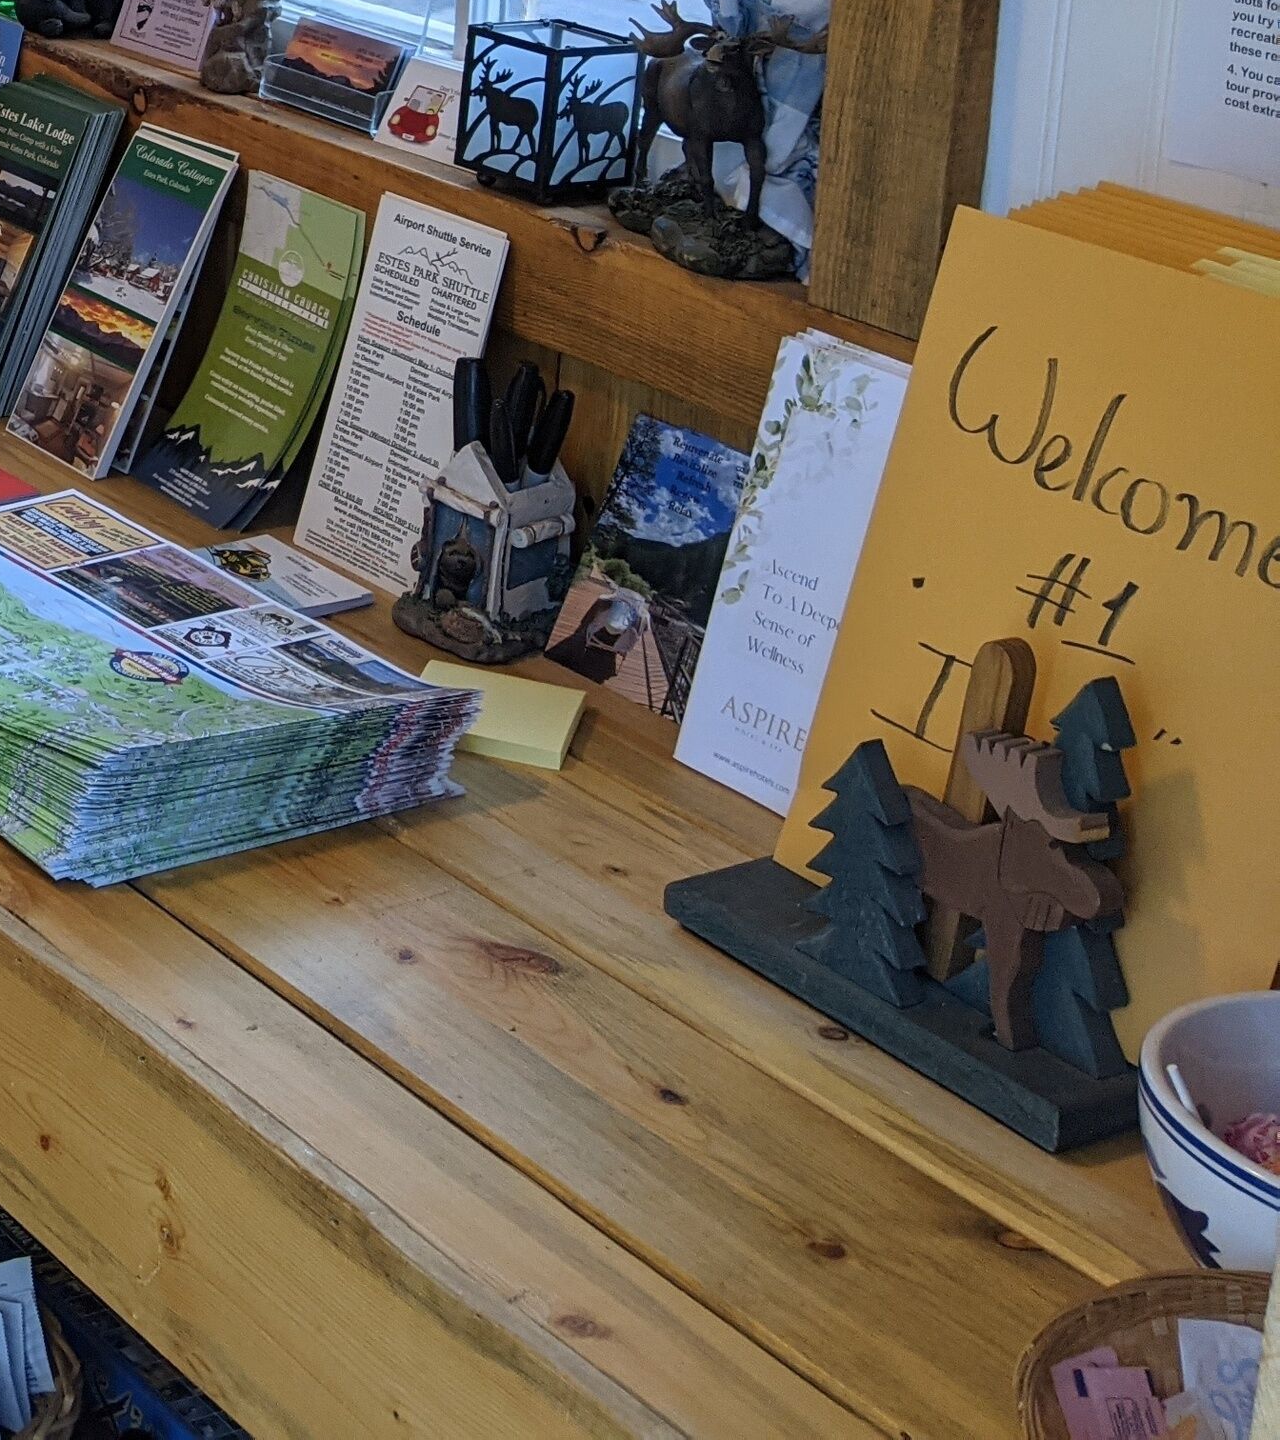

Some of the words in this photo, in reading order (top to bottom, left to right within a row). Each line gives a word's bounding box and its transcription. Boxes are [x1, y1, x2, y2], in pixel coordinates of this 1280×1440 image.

[1229, 40, 1263, 58] these
[1225, 78, 1251, 94] tour
[1224, 95, 1252, 112] cost
[20, 112, 44, 133] Lake
[45, 121, 76, 147] Lodge
[135, 142, 174, 171] Colorado
[177, 159, 216, 186] Cottages
[393, 213, 426, 234] Airport
[426, 224, 458, 245] Shuttle
[458, 236, 492, 258] Service
[374, 263, 420, 288] SCHEDULED
[377, 251, 411, 273] ESTES
[414, 264, 440, 285] PARK
[442, 276, 490, 304] SHUTTLE
[431, 286, 478, 311] CHARTERED
[396, 310, 441, 337] Schedule
[672, 437, 724, 465] Rejuvenate
[763, 558, 820, 592] Ascend
[752, 610, 795, 640] Sense
[797, 634, 816, 648] of
[746, 635, 805, 675] Wellness
[720, 695, 808, 752] ASPIRE
[712, 750, 791, 795] www.aspirehotels.com
